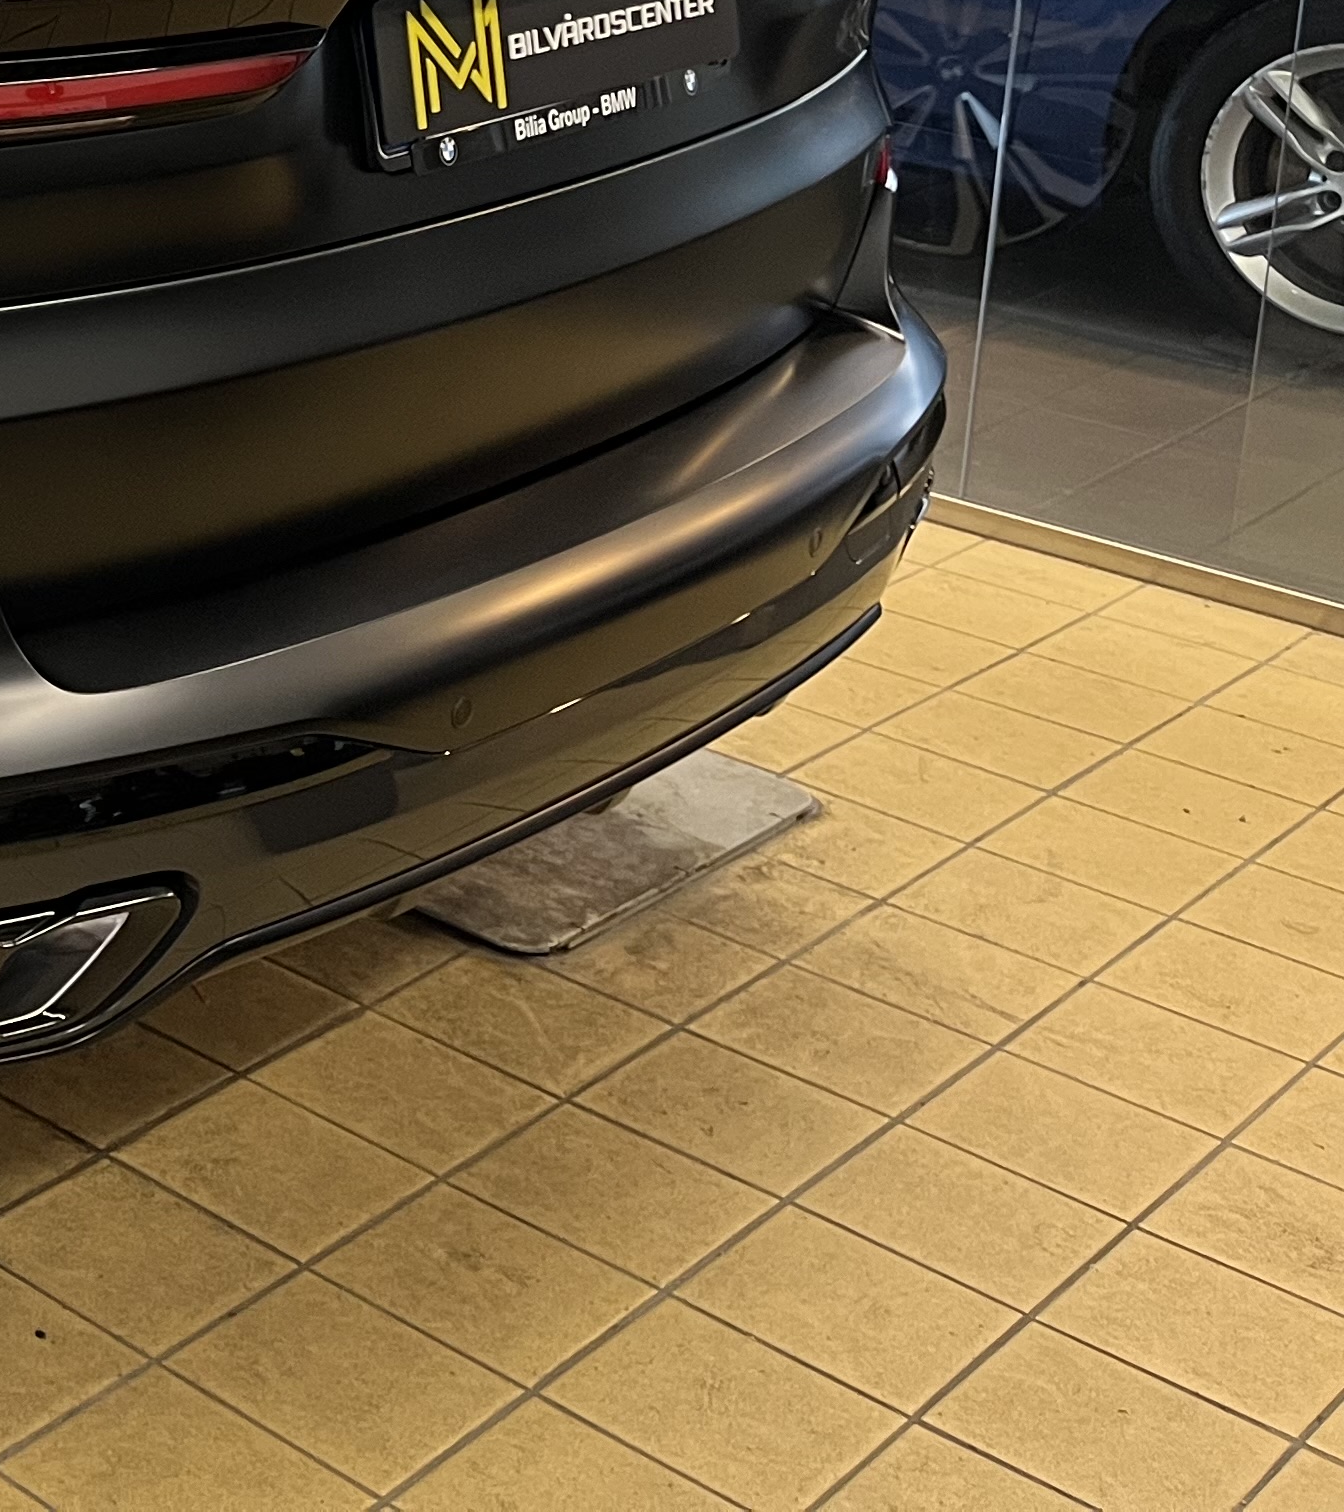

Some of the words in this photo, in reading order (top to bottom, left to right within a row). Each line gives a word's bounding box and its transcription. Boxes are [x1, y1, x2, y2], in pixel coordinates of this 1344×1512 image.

[514, 114, 548, 141] Bilia
[548, 105, 591, 127] Group
[600, 87, 637, 116] BMW
